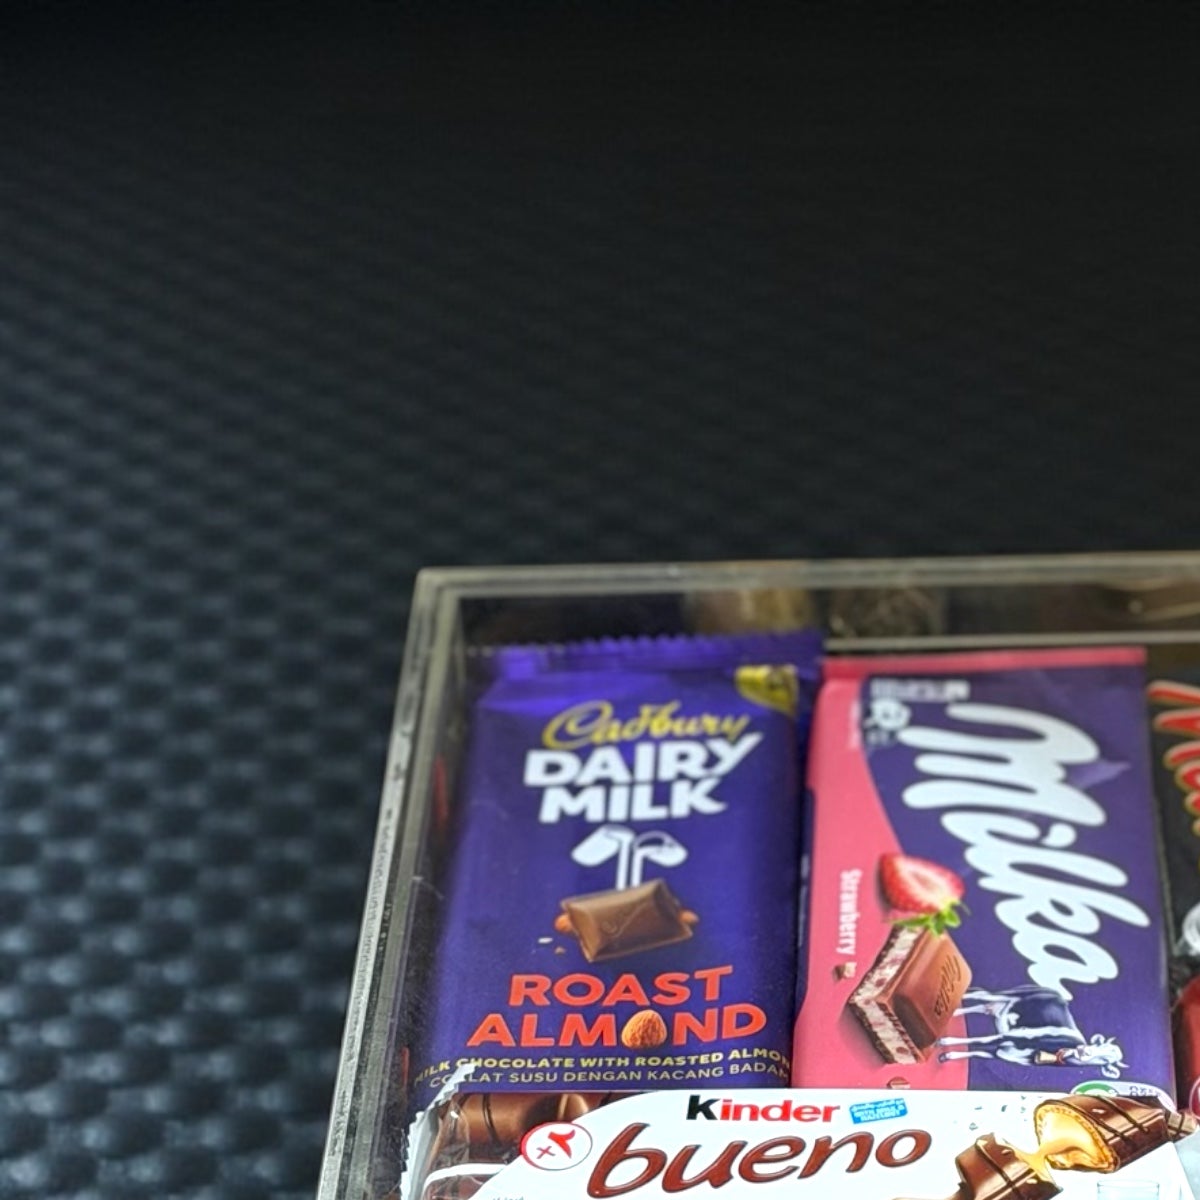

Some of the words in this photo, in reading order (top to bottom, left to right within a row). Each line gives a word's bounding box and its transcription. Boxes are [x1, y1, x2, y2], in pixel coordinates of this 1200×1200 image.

[541, 699, 750, 749] Cadbury
[524, 733, 764, 787] DAIRY
[539, 778, 727, 824] MILK
[900, 704, 1151, 1001] Milka
[837, 869, 862, 955] Strawberry
[508, 966, 733, 1006] ROAST
[456, 1057, 575, 1070] CHOCOLATE
[580, 1056, 630, 1067] WITH
[635, 1051, 723, 1067] ROASTED
[509, 1071, 557, 1083] SUSU
[563, 1070, 641, 1082] DENGAN
[647, 1066, 723, 1080] KACANG
[686, 1094, 839, 1123] Kinder
[587, 1122, 931, 1199] bueno
